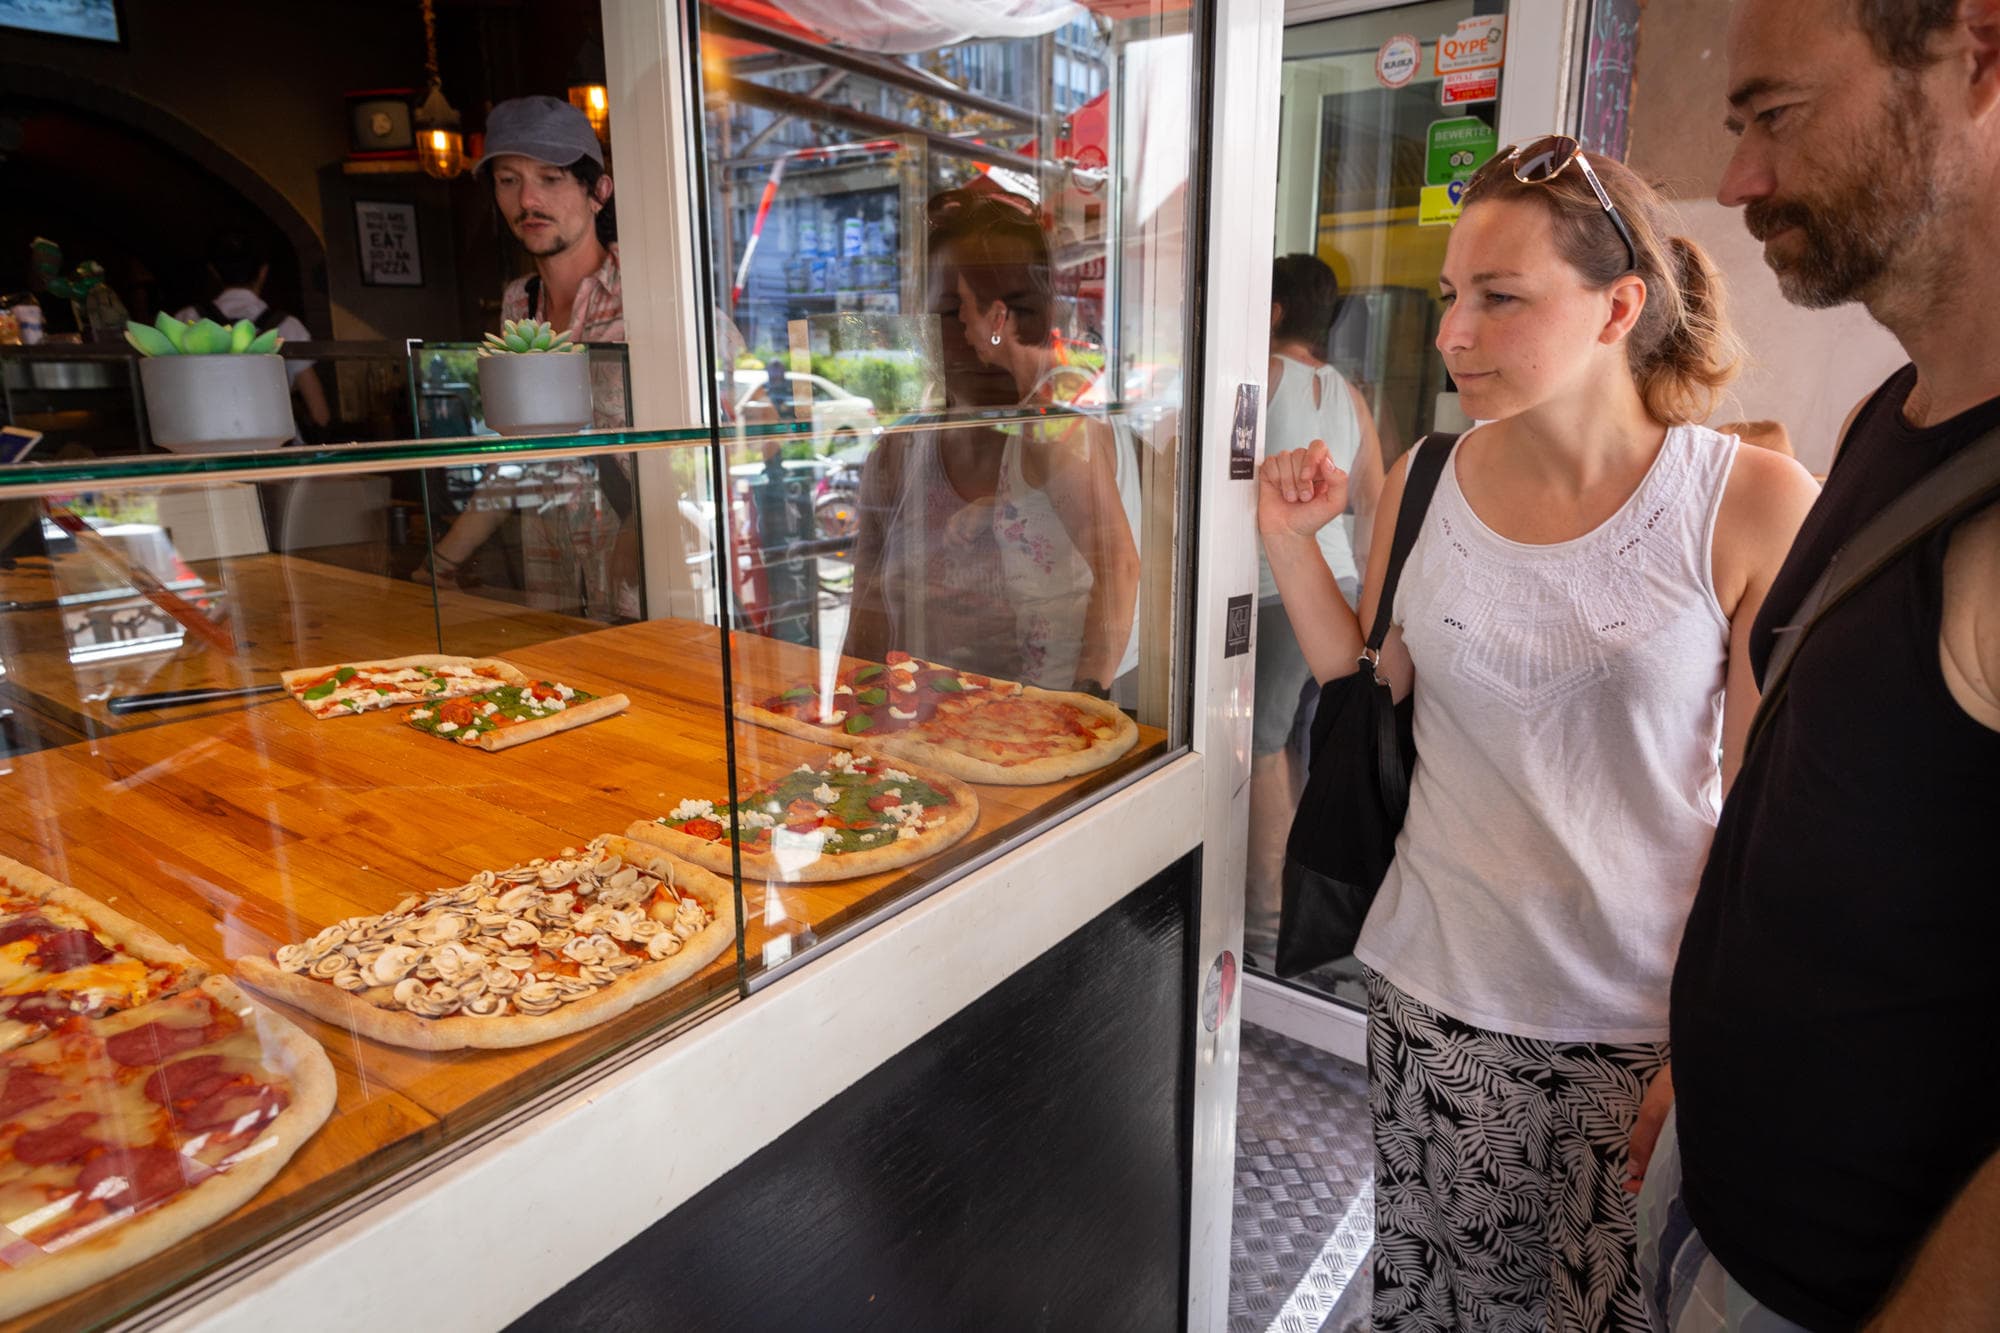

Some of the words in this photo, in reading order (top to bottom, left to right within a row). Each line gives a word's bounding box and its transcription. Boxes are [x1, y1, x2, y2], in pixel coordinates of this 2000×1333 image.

[1443, 37, 1488, 60] QYPE
[1434, 127, 1493, 142] BEWERTET
[370, 232, 405, 249] EAT
[370, 260, 410, 275] PIZZA
